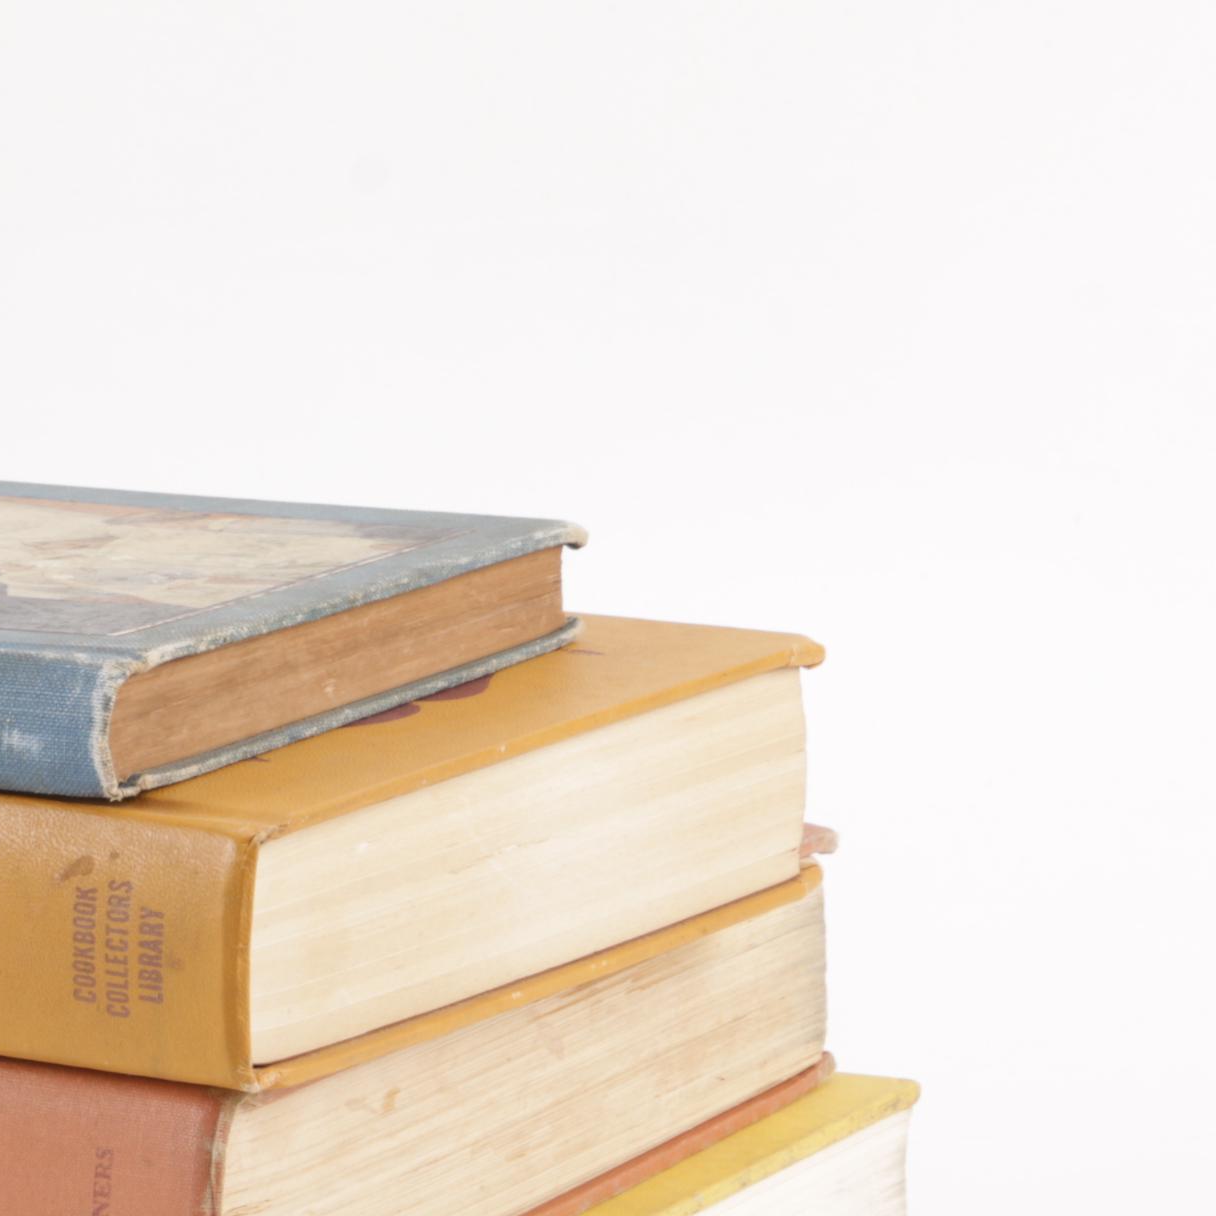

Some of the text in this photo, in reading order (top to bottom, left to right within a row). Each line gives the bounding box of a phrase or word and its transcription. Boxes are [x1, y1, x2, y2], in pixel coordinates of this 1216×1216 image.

[72, 886, 98, 1004] COOKBOOK
[105, 880, 133, 1018] COLLECTORS
[137, 906, 165, 1005] LIBRARY
